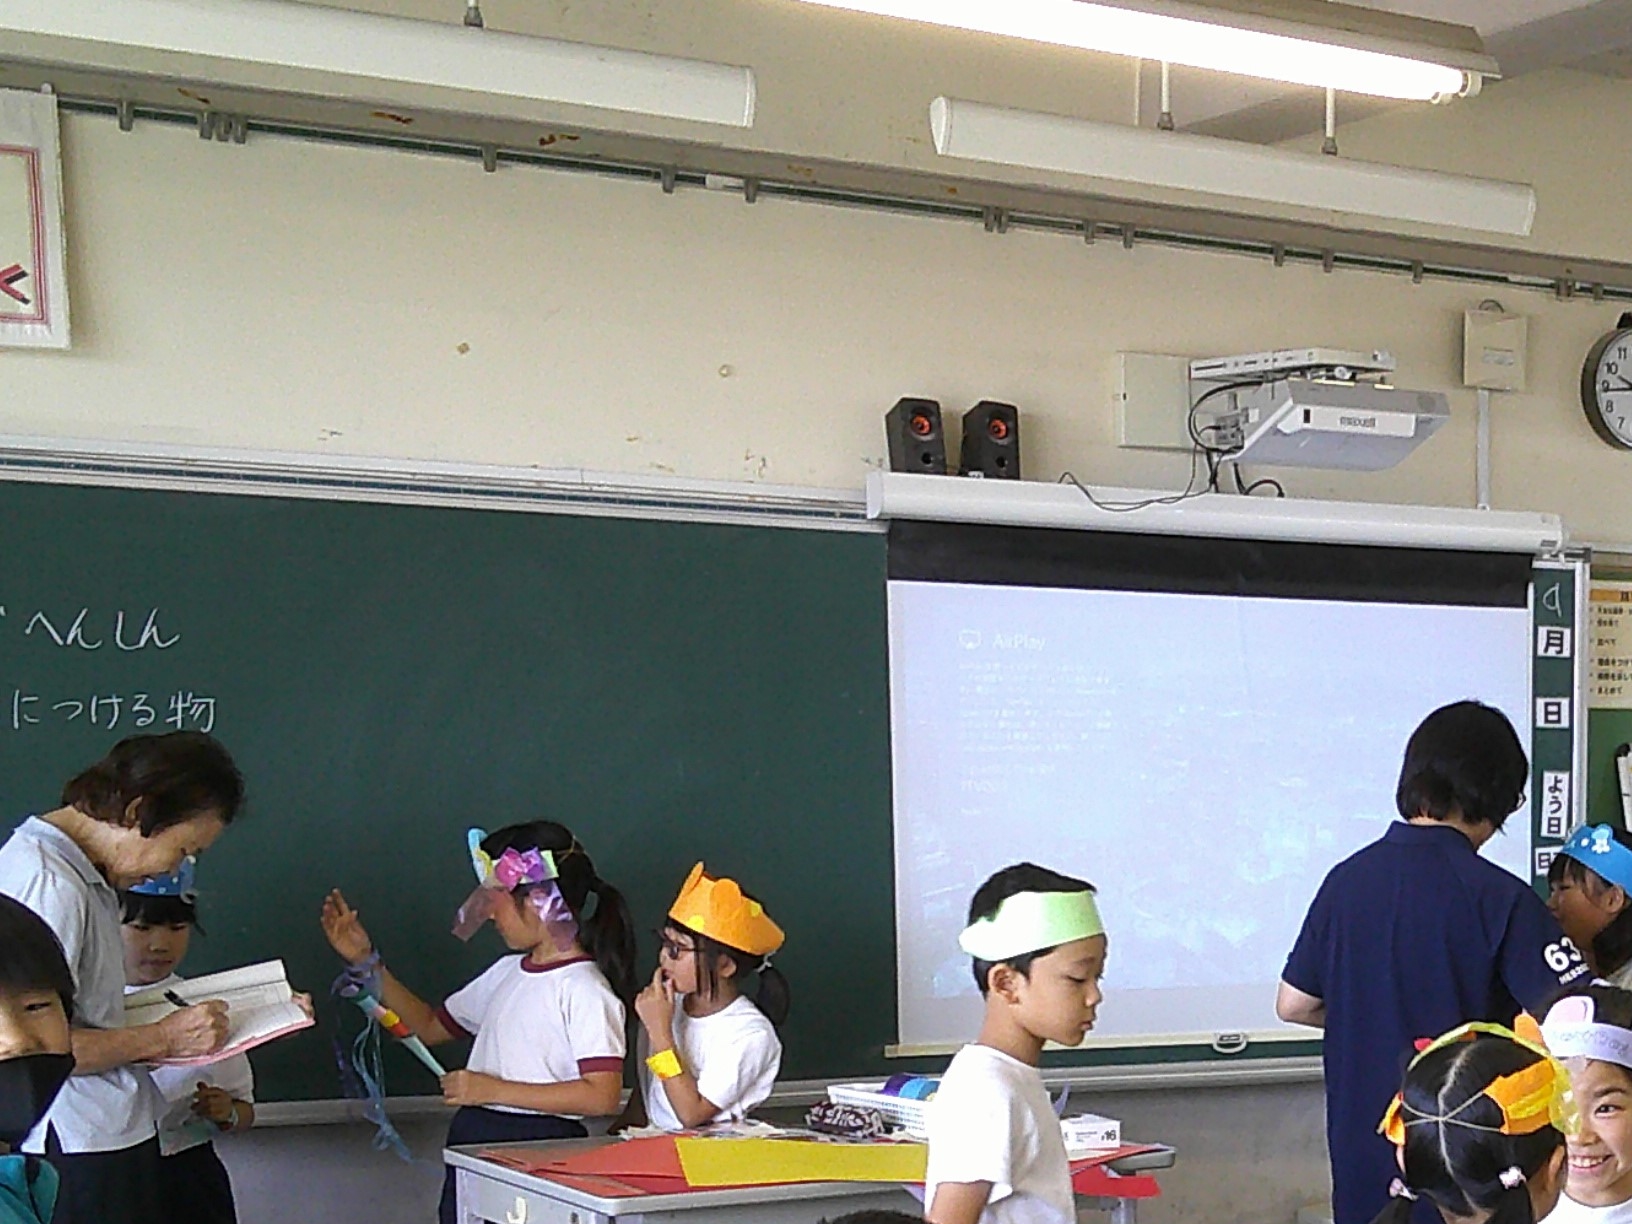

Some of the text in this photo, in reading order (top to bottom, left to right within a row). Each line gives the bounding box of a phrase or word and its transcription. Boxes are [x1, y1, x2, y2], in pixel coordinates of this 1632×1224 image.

[1617, 346, 1628, 361] 11
[1606, 361, 1618, 376] 10
[1605, 400, 1614, 413] 8
[1617, 416, 1626, 430] 7
[992, 633, 1047, 651] AirPlay
[1543, 629, 1565, 655] 月
[14, 689, 216, 733] につける物
[1544, 702, 1563, 725] 日
[1547, 775, 1563, 834] よう日
